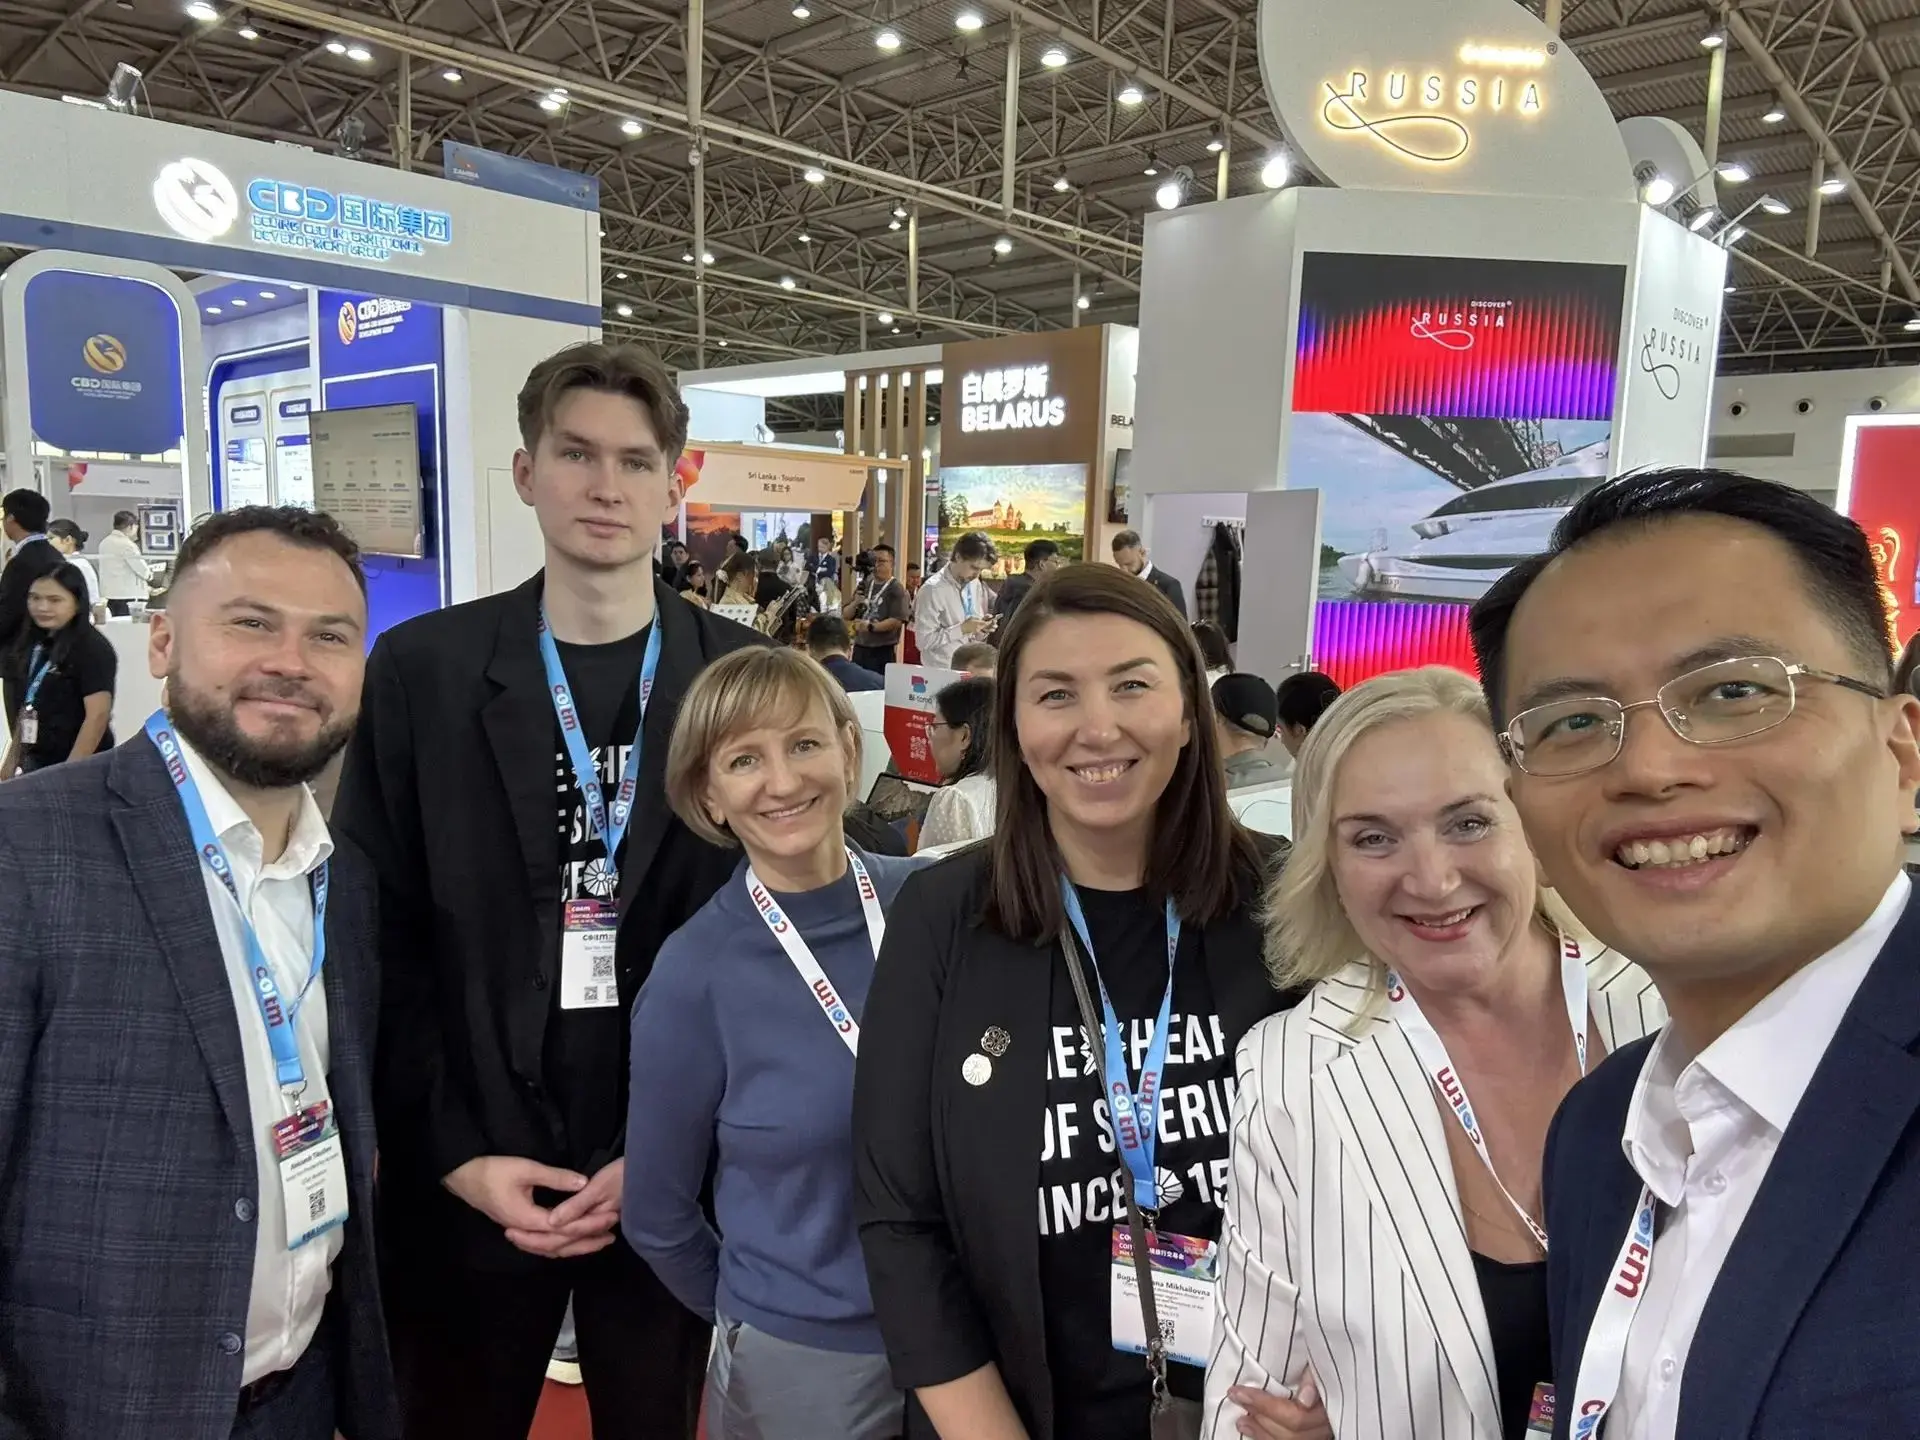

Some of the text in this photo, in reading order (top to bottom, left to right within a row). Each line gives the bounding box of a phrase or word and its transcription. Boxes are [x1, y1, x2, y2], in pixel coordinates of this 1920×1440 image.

[1350, 71, 1541, 110] RUSSIA
[1421, 312, 1505, 329] RUSSIA
[1672, 307, 1704, 331] DISCOVER
[1650, 328, 1701, 365] RUSSIA
[961, 397, 1067, 433] BELARUS
[748, 472, 806, 483] Sri Lanka Tourism
[763, 483, 791, 493] 斯里兰卡
[751, 884, 788, 934] coitm
[256, 966, 285, 1028] coitm
[812, 978, 852, 1033] coitm
[1111, 1081, 1139, 1150] coitm
[1436, 1066, 1481, 1146] coitm
[1166, 1282, 1211, 1297] Mikhailovna
